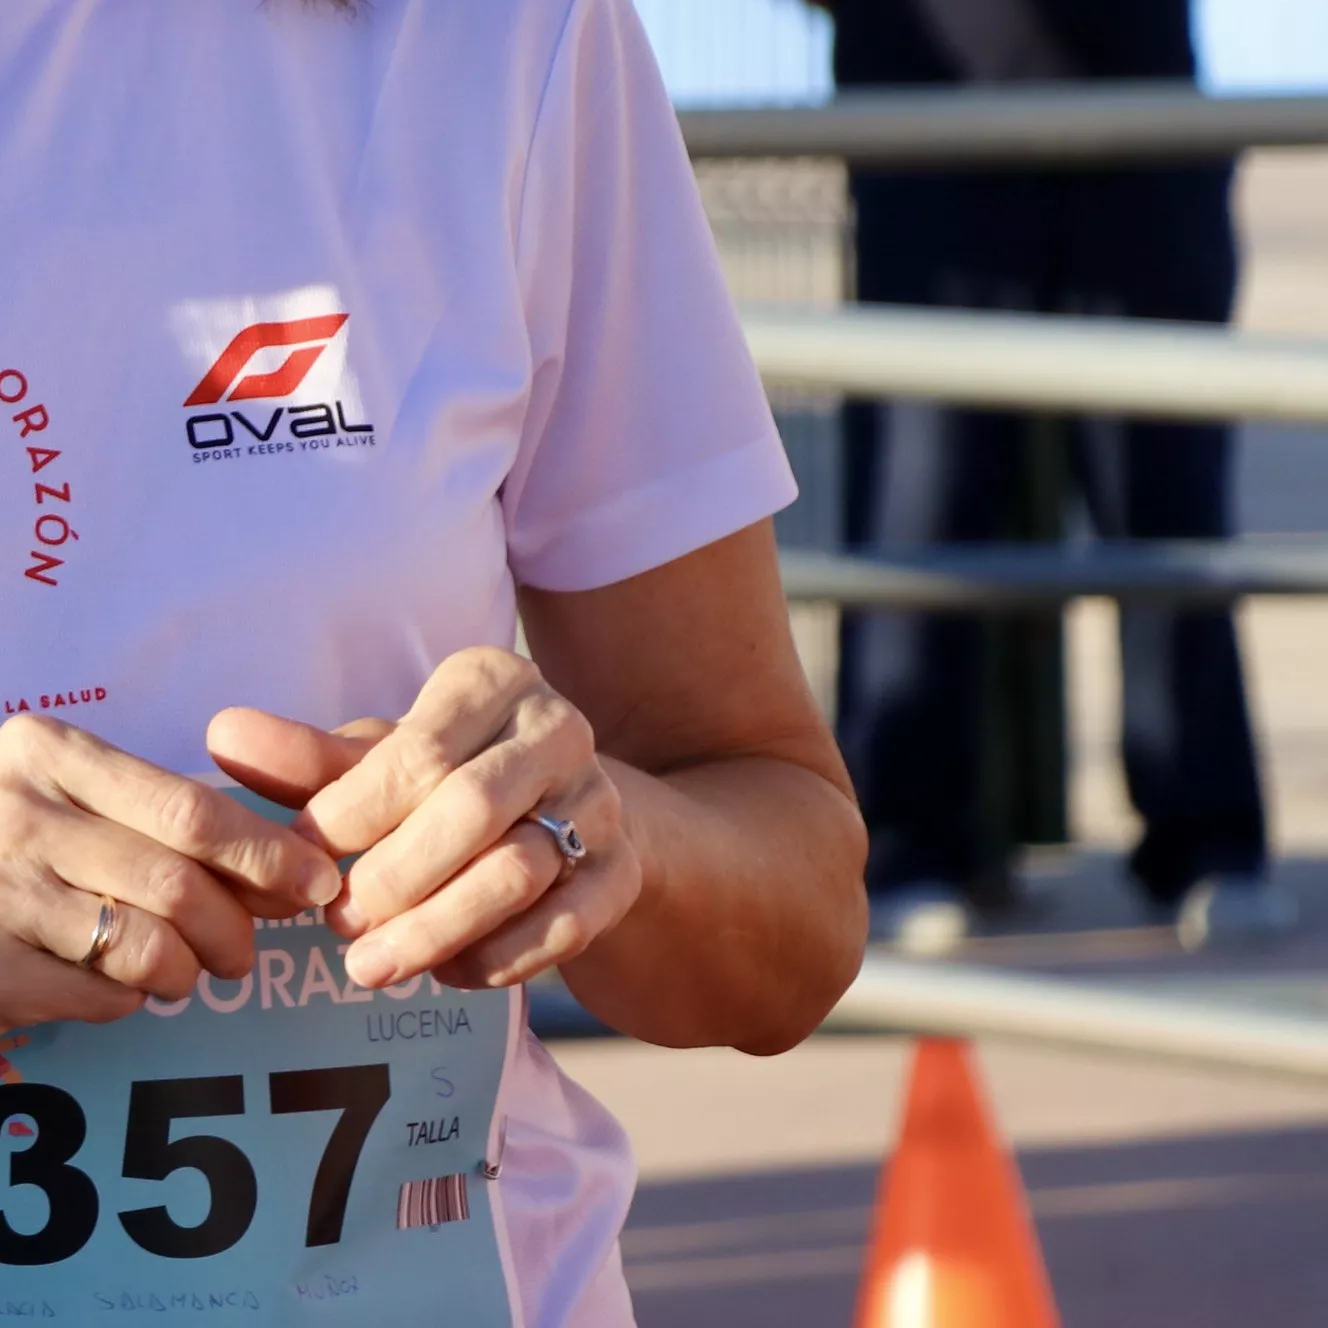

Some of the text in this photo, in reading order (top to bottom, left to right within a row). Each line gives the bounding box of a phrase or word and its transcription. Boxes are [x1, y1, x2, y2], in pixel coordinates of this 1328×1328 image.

[192, 434, 376, 464] SPORT KEEPS YOU ALIVE
[5, 699, 30, 714] LA
[39, 686, 108, 709] SALUD
[367, 1007, 472, 1043] LUCENA
[430, 1065, 456, 1099] S
[406, 1116, 460, 1147] TALLA
